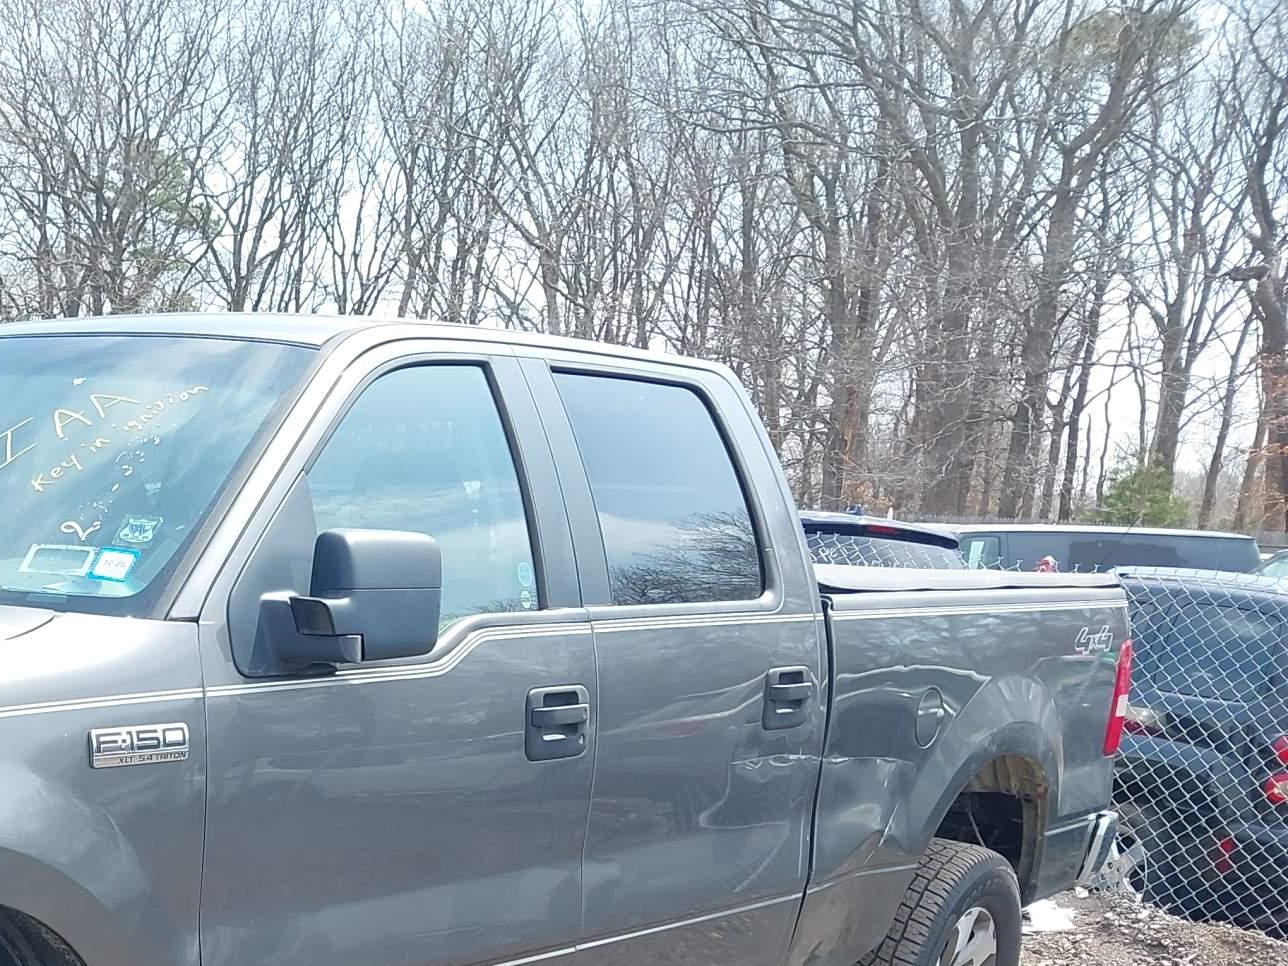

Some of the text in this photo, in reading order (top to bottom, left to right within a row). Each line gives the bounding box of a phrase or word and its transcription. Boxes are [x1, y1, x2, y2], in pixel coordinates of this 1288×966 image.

[80, 437, 111, 452] in
[1075, 625, 1113, 655] 4x4
[118, 756, 134, 764] XLT
[155, 751, 187, 761] TRITON
